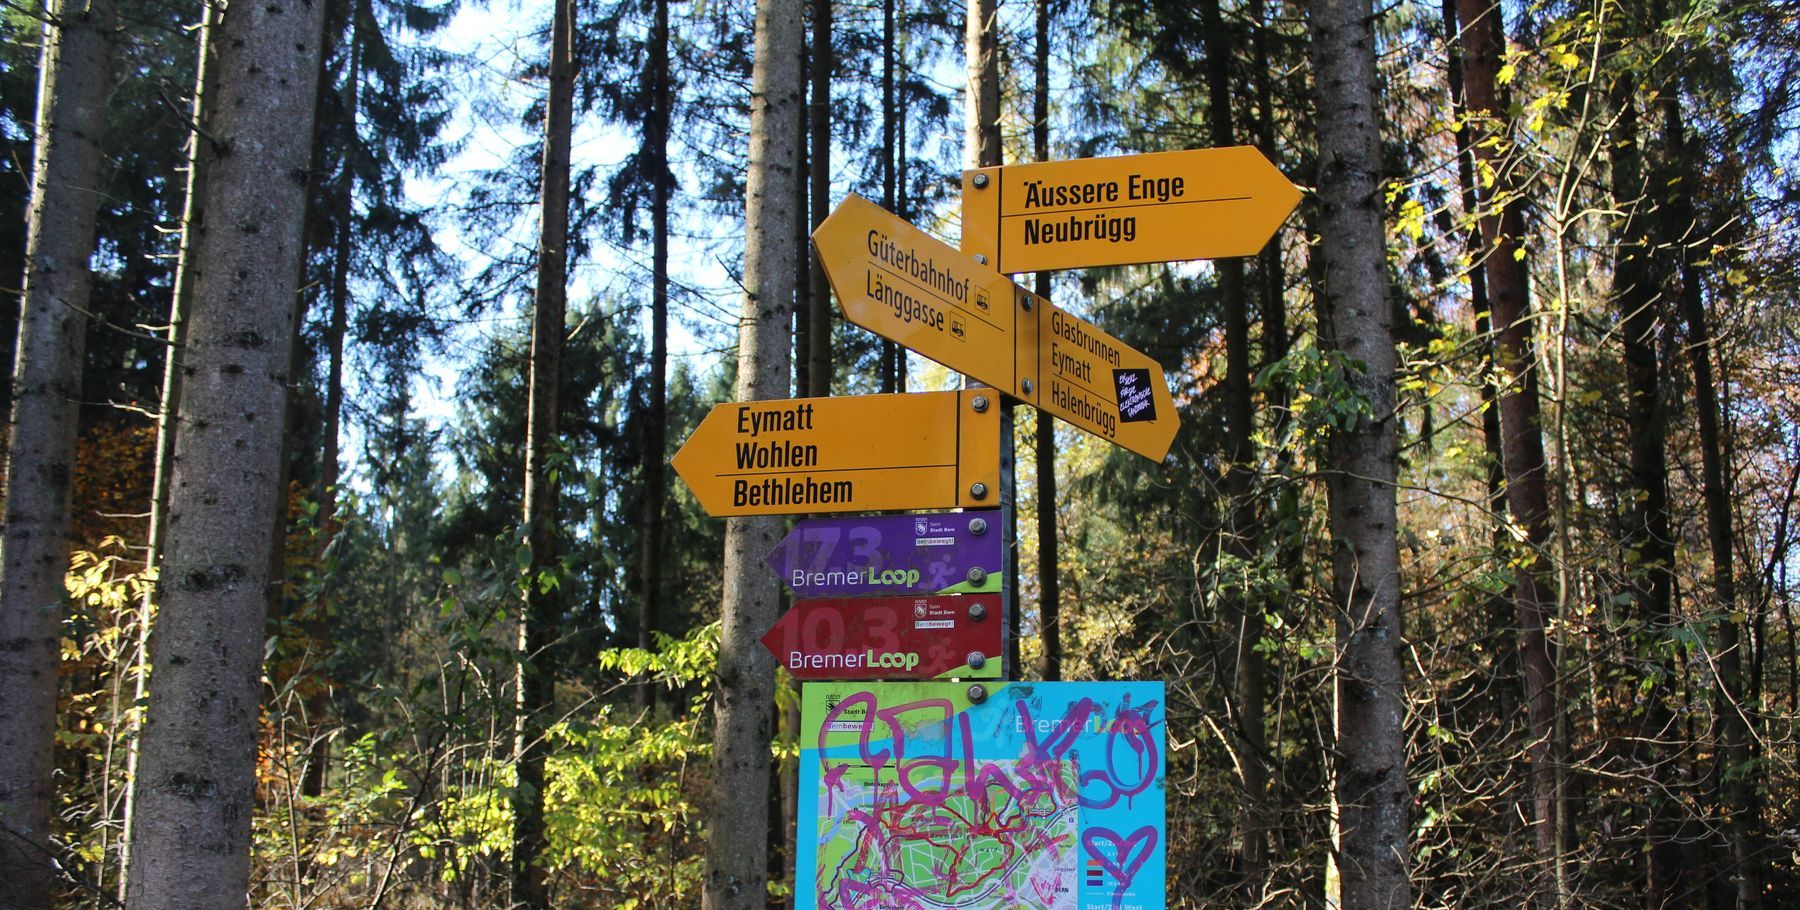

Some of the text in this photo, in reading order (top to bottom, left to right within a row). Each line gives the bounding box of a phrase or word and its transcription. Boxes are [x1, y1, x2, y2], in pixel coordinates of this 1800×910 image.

[1023, 174, 1185, 209] Äussere Enge
[1024, 213, 1137, 246] Neubrügg
[867, 228, 970, 304] Güterbahnhof
[866, 268, 945, 332] Länggasse
[1051, 311, 1121, 368] Glasbrunnen
[1051, 346, 1092, 384] Eymatt
[737, 403, 814, 437] Eymatt
[1051, 380, 1117, 439] Halenbrügg
[735, 440, 818, 470] Wohlen
[733, 476, 854, 508] Bethlehem
[791, 566, 921, 588] BremerLoop
[789, 649, 920, 672] BremerLoop
[826, 722, 868, 730] Bernbewe
